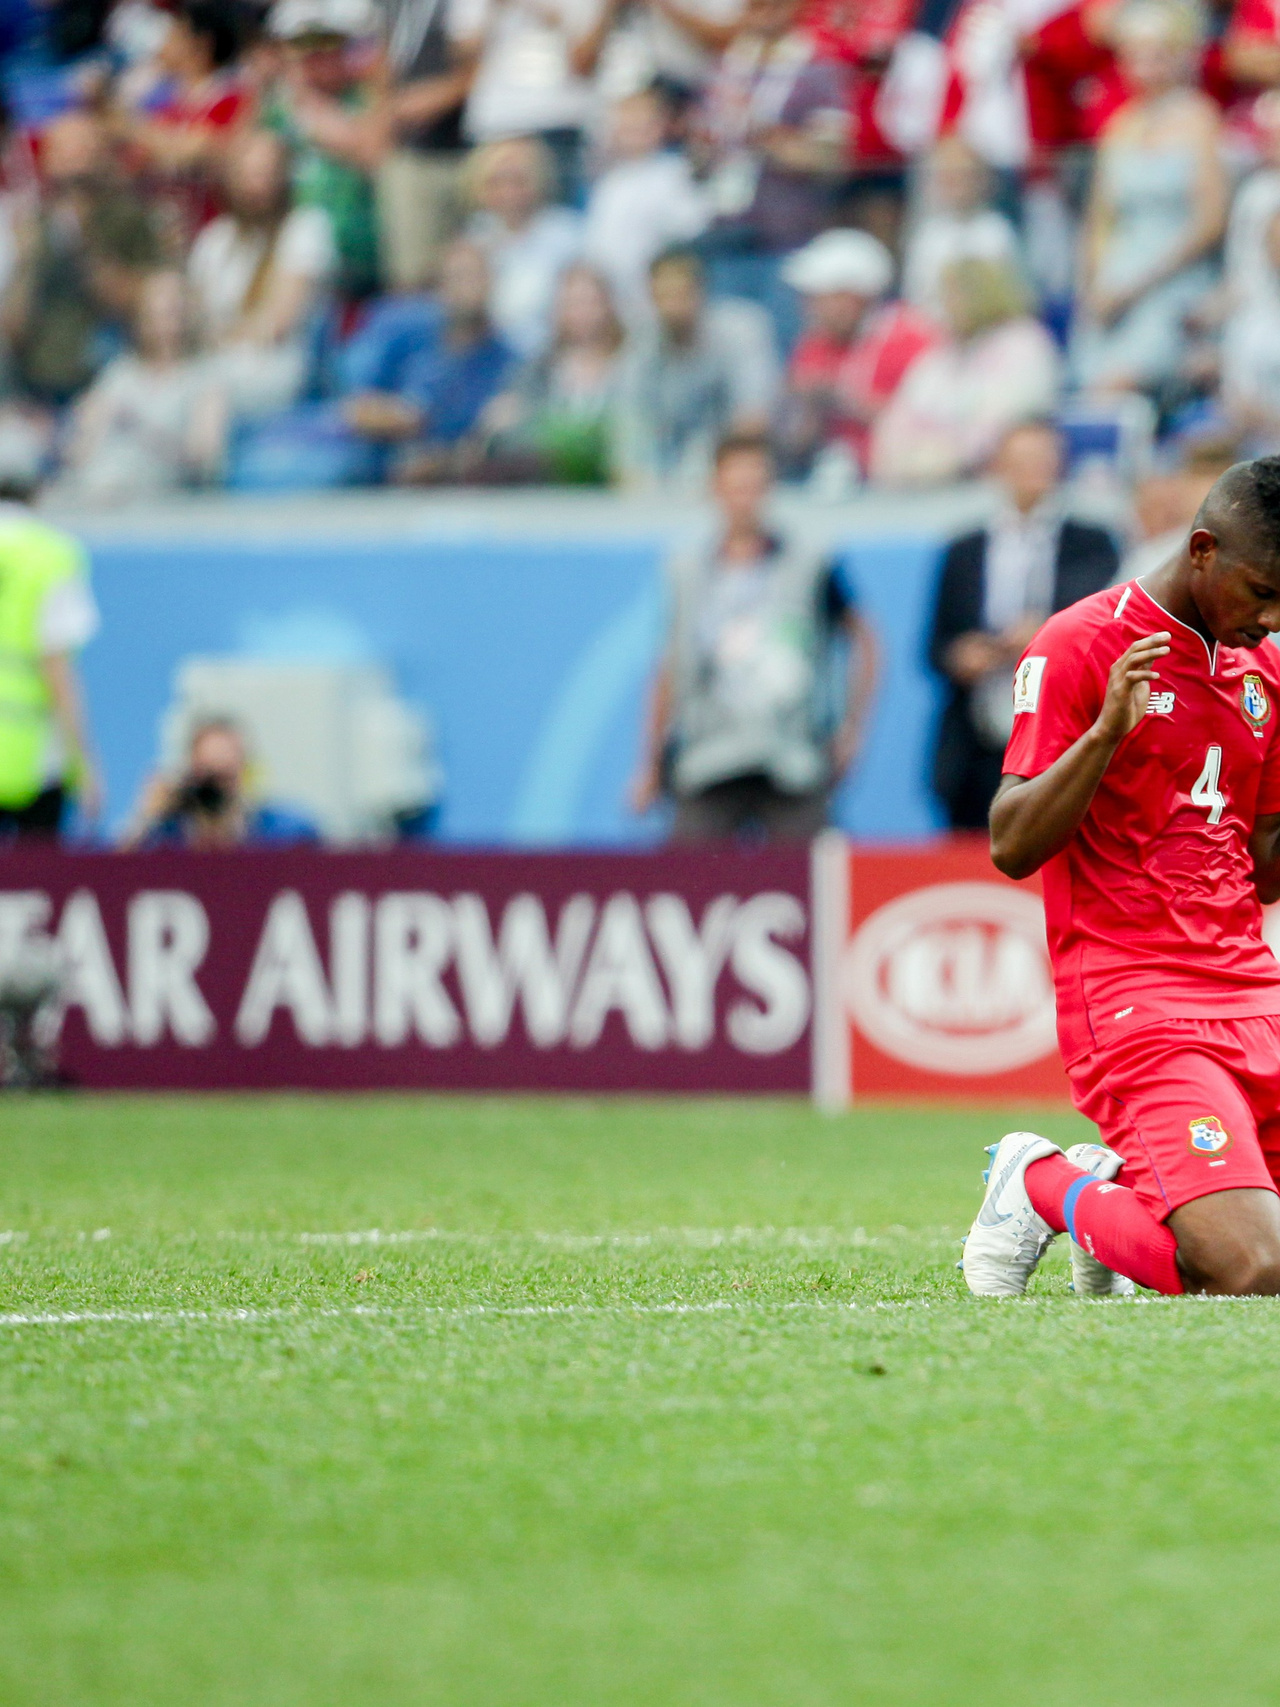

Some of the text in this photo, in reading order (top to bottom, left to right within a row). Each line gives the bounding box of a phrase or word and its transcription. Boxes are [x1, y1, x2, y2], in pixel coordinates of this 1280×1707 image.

[1190, 746, 1226, 825] 4
[235, 888, 811, 1054] AIRWAYS
[893, 928, 1052, 1020] KIA
